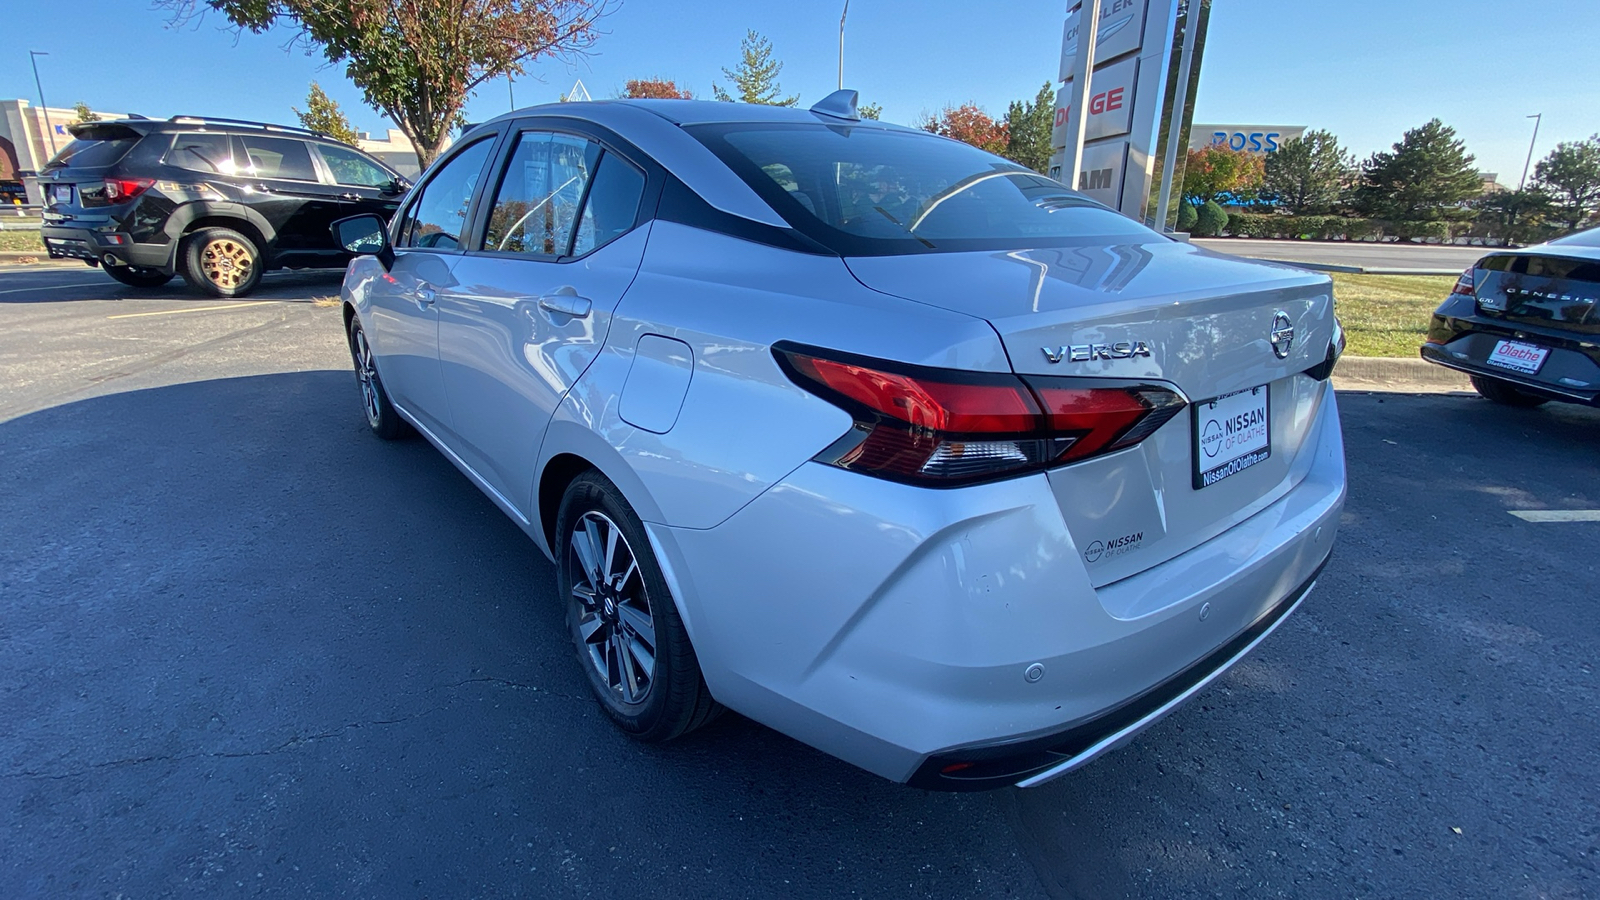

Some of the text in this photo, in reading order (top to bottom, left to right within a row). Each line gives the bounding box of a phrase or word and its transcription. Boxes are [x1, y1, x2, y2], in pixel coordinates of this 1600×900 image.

[1066, 0, 1133, 41] CHLER
[1055, 87, 1124, 127] DGE
[159, 182, 208, 192] HPD
[1079, 168, 1113, 190] AM
[1506, 288, 1594, 304] GENESIS
[1040, 341, 1151, 364] VERSA
[1498, 344, 1540, 361] Olathe
[1225, 407, 1265, 436] NISSAN
[1201, 432, 1224, 445] NISSAN
[1225, 424, 1265, 450] OF OLATHE
[1203, 451, 1269, 487] NissanOfOlathe.com
[1105, 541, 1142, 558] OF OLATHE
[1106, 531, 1143, 550] NISSAN
[1084, 547, 1105, 556] NISSAN
